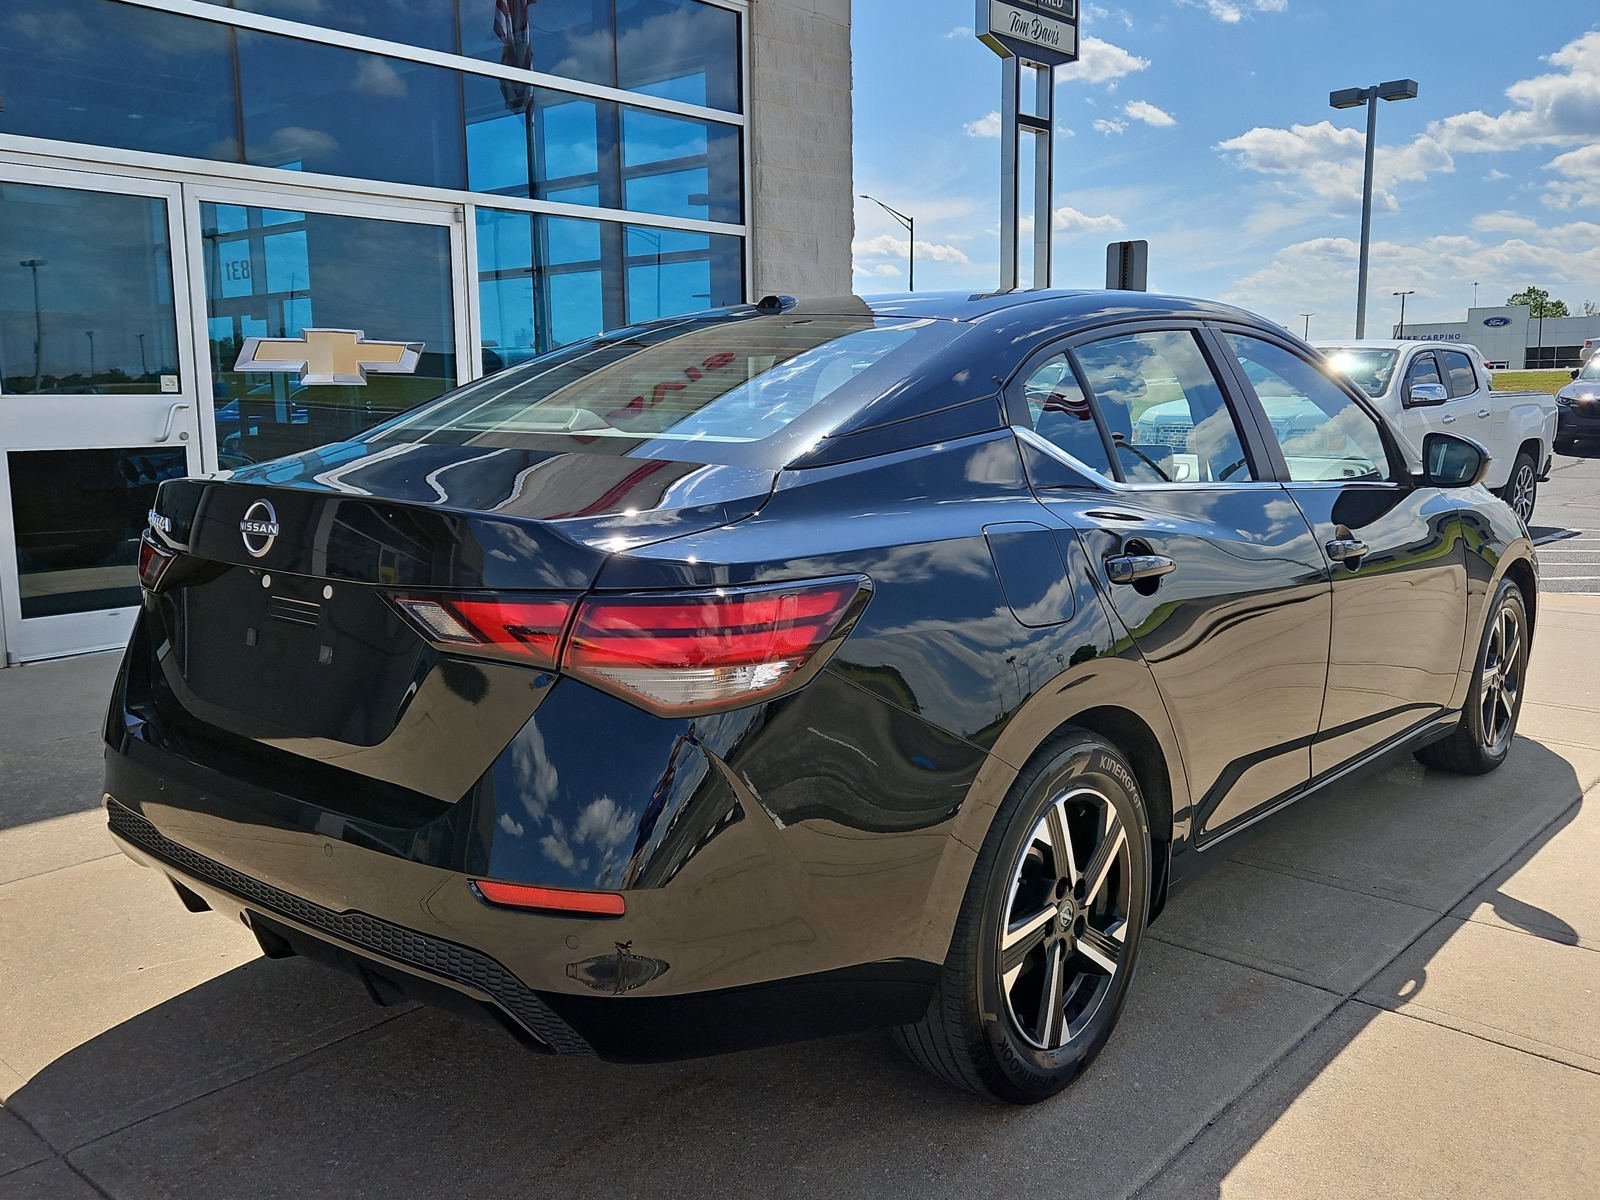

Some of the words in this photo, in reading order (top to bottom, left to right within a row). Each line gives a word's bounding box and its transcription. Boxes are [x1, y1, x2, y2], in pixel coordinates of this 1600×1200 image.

[1008, 11, 1029, 36] Tom
[1031, 18, 1060, 45] Davis
[1421, 333, 1460, 341] CARPINO
[240, 521, 278, 535] NISSAN
[1099, 755, 1136, 793] KINERGY
[1132, 793, 1142, 809] GT
